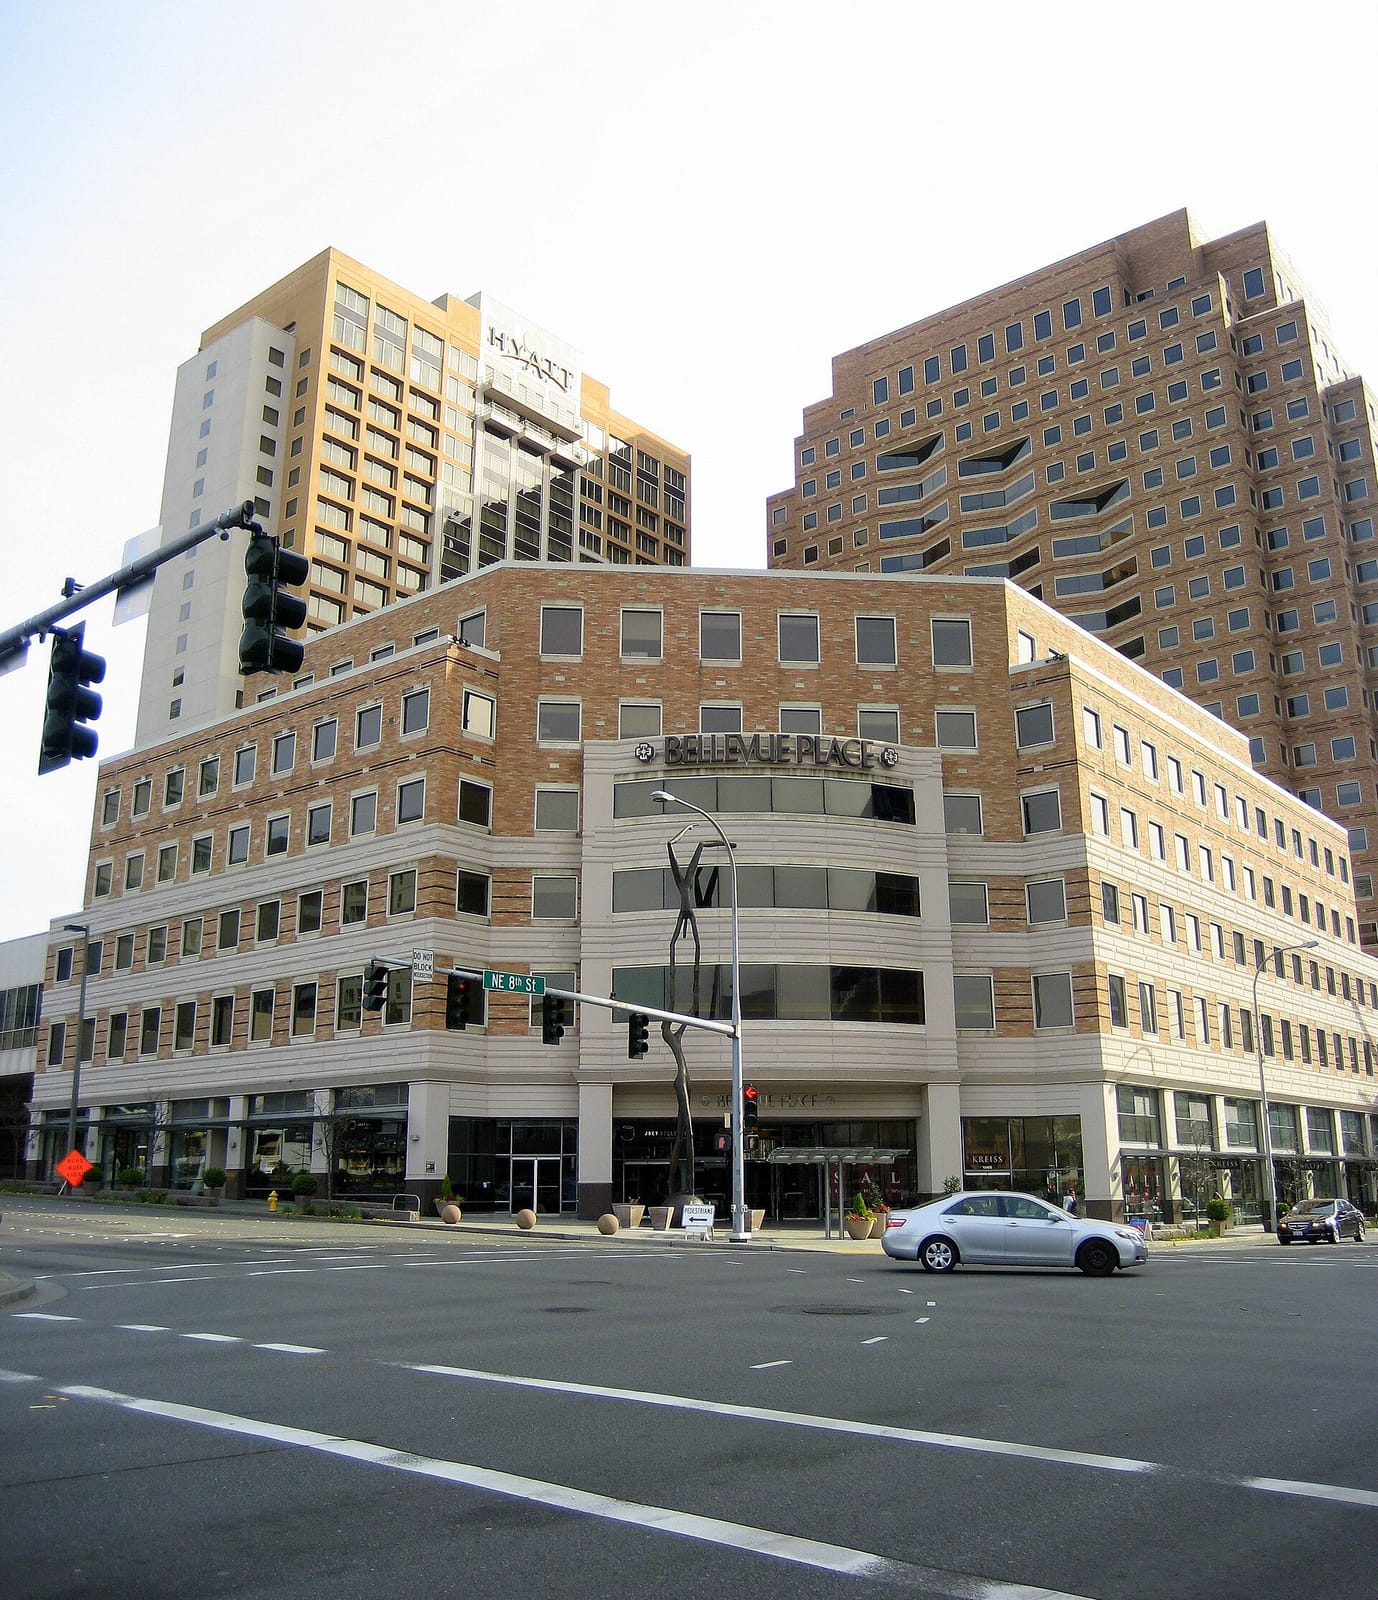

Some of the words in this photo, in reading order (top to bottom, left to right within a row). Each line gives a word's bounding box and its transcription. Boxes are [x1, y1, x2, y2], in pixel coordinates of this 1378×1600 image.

[487, 326, 574, 389] HYATT
[664, 733, 791, 766] BELLEVUE
[797, 735, 875, 768] PLACE
[414, 951, 421, 960] DO
[423, 953, 433, 961] NOT
[414, 962, 433, 971] BLOCK
[491, 973, 505, 989] NE
[508, 976, 522, 990] 8th
[525, 978, 537, 992] St
[972, 1155, 1003, 1163] KREISS
[685, 1207, 713, 1215] PEDESTRIANS
